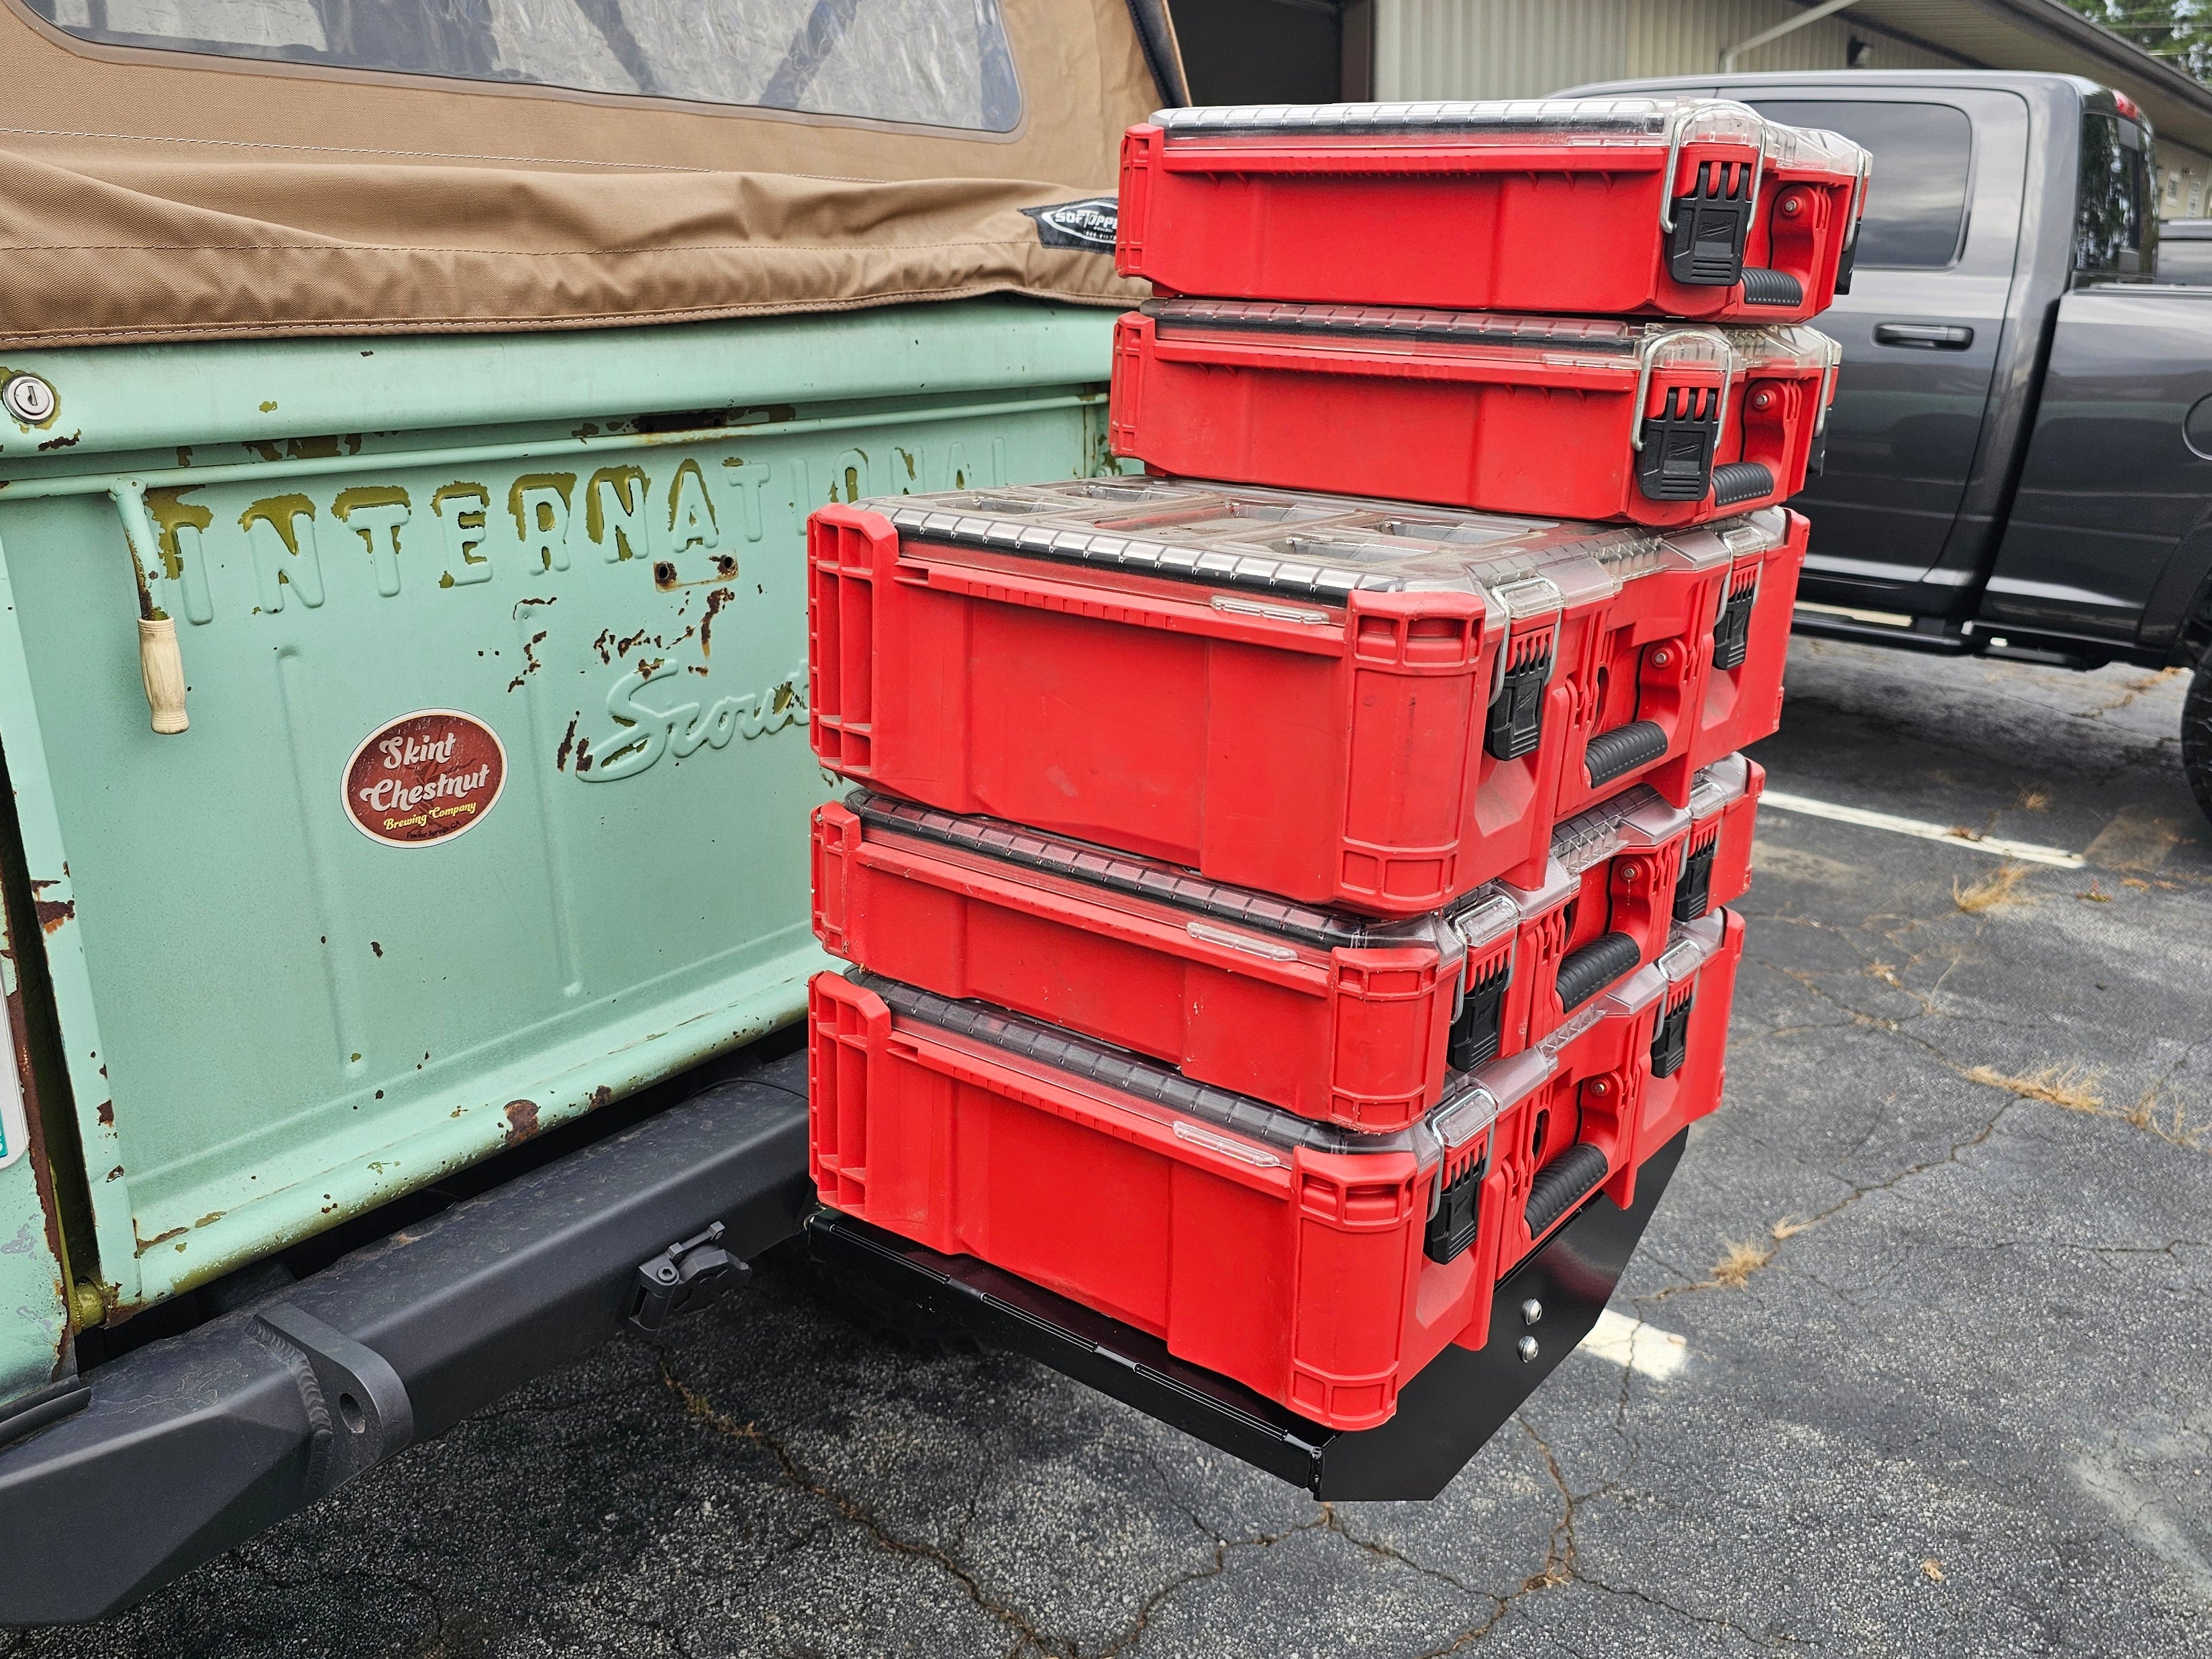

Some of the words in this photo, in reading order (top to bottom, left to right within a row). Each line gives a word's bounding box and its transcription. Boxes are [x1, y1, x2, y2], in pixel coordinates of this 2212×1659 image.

[576, 658, 809, 783] Scout
[379, 733, 456, 769] Skint
[359, 764, 490, 811] Chestnut
[383, 813, 428, 831] Brewing
[428, 802, 476, 819] Company
